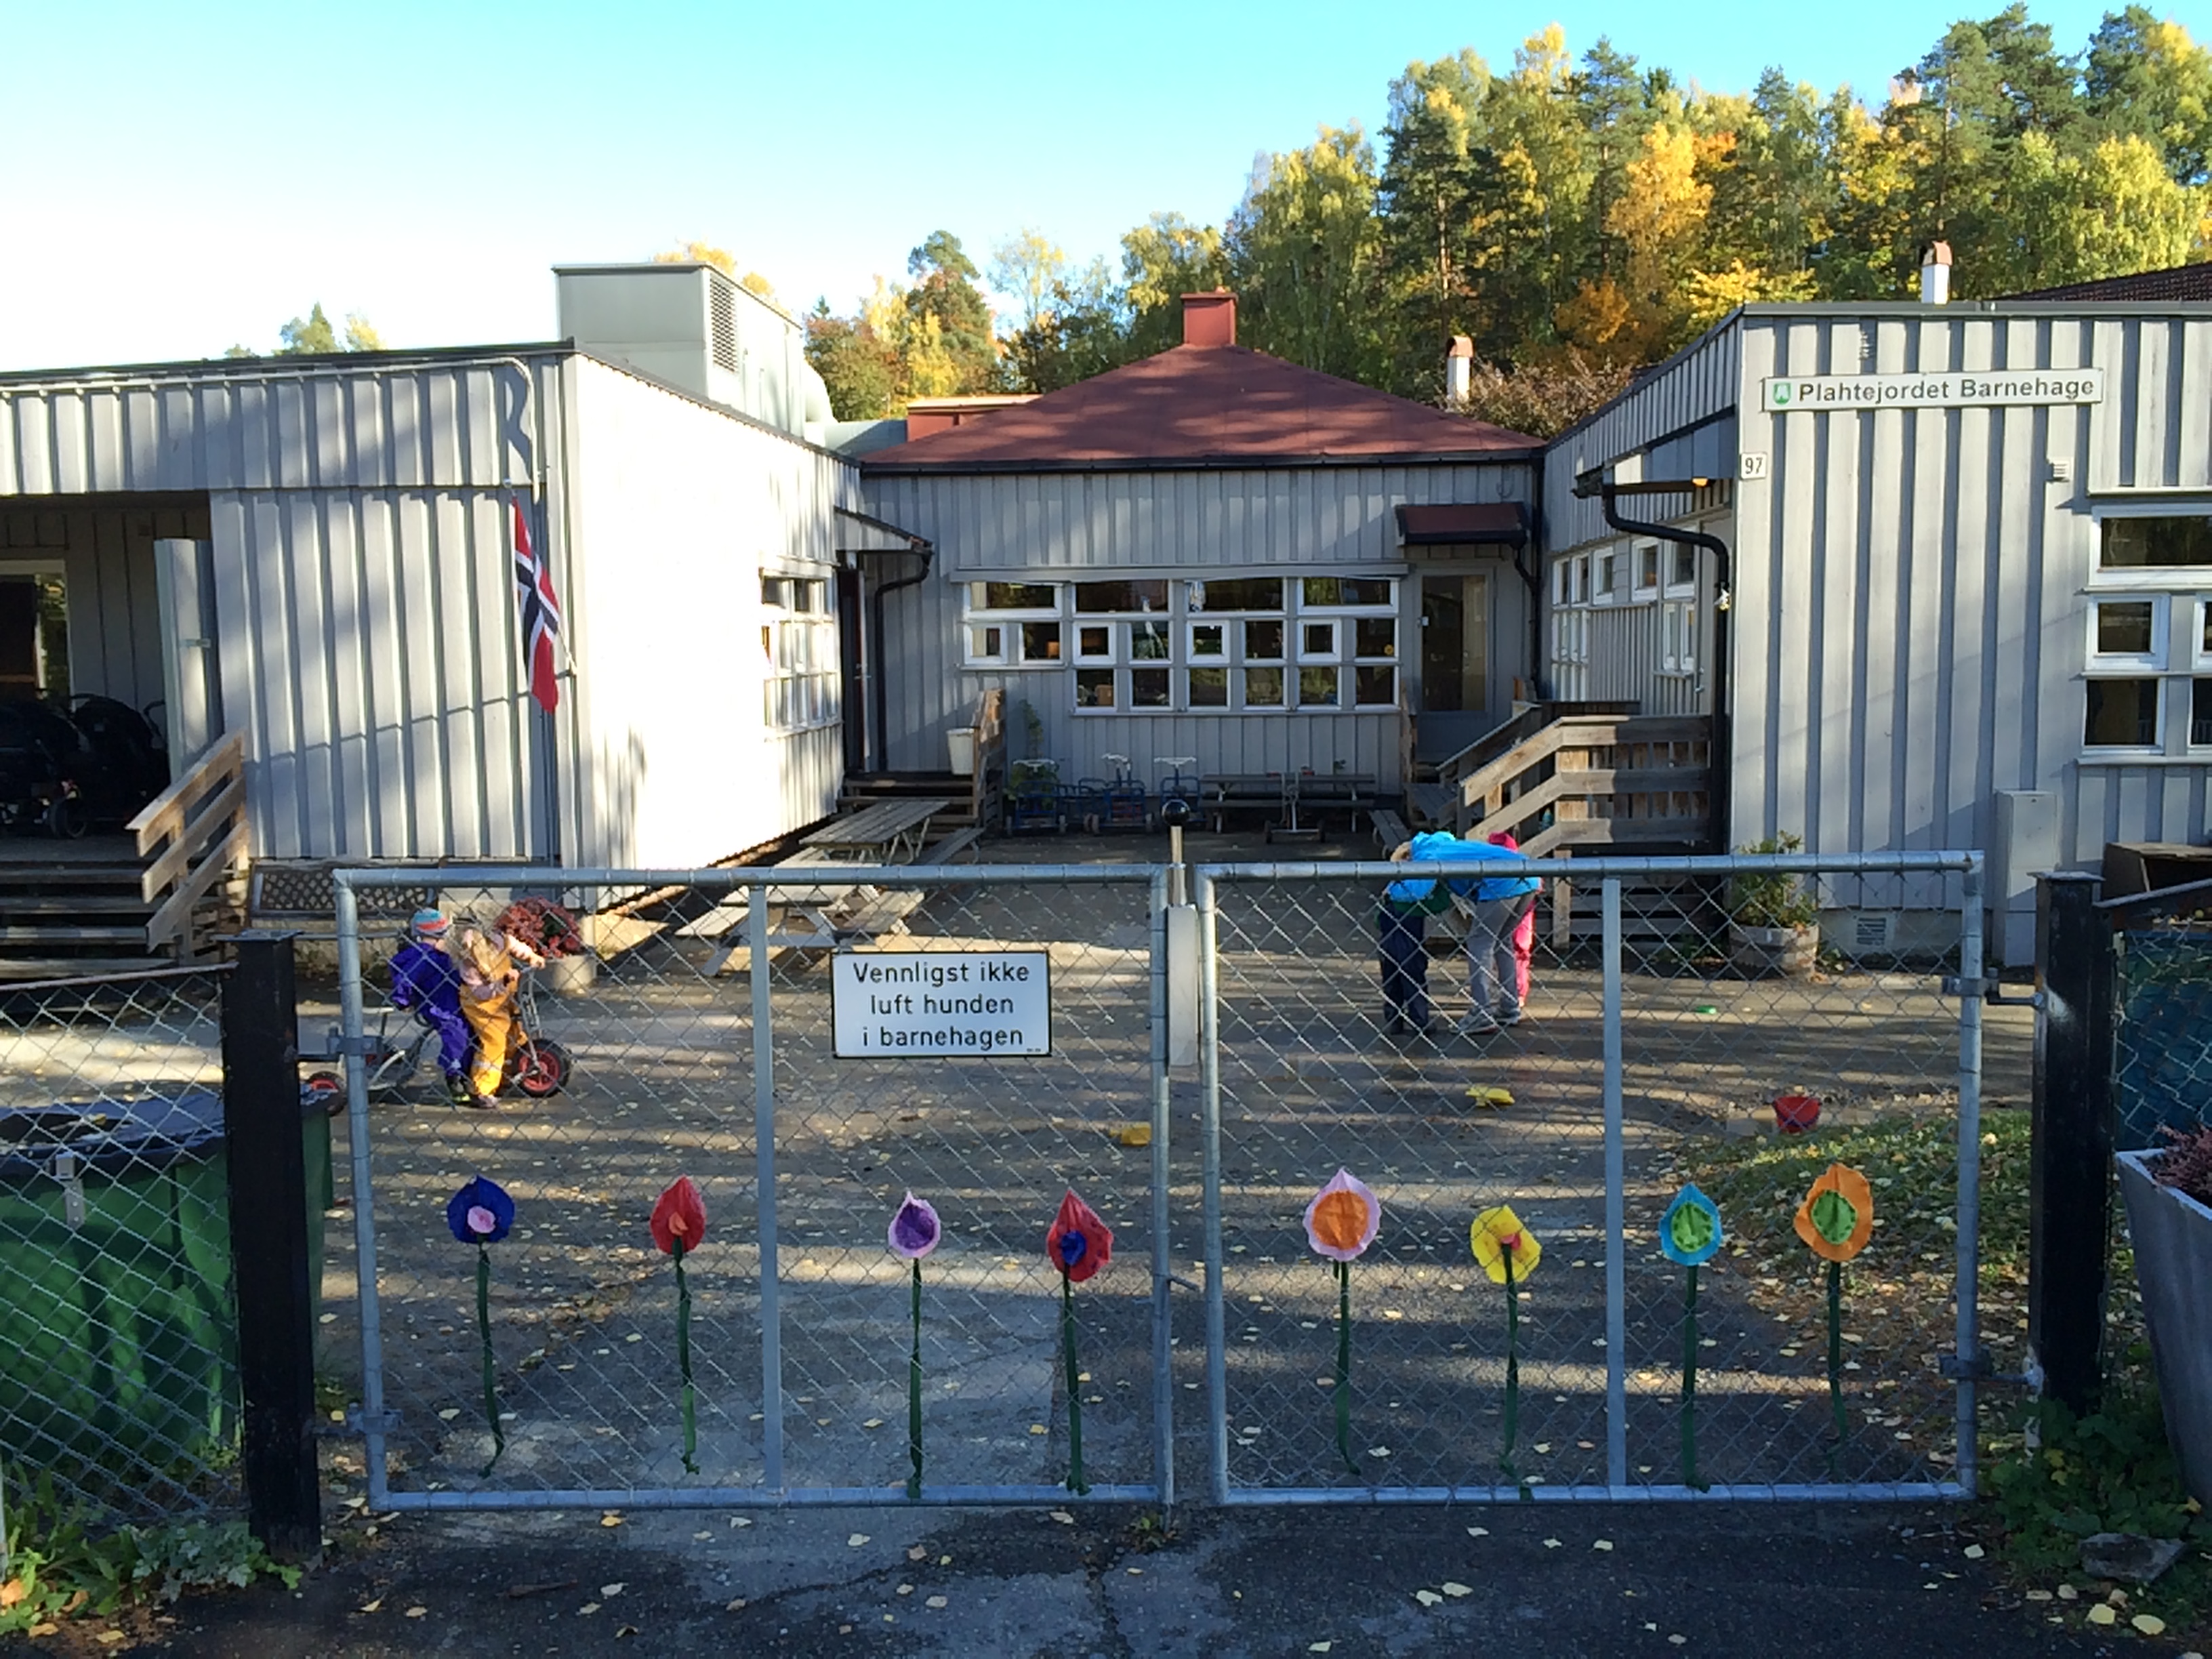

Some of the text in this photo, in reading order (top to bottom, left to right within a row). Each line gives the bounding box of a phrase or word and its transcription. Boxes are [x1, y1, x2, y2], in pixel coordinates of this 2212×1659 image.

[1799, 377, 2094, 405] Plahtejordet Barnehage
[1745, 457, 1763, 474] 97
[853, 961, 1030, 987] Vennligst ikke
[871, 994, 1015, 1015] luft hunden
[862, 1025, 1024, 1051] i barnehagen
